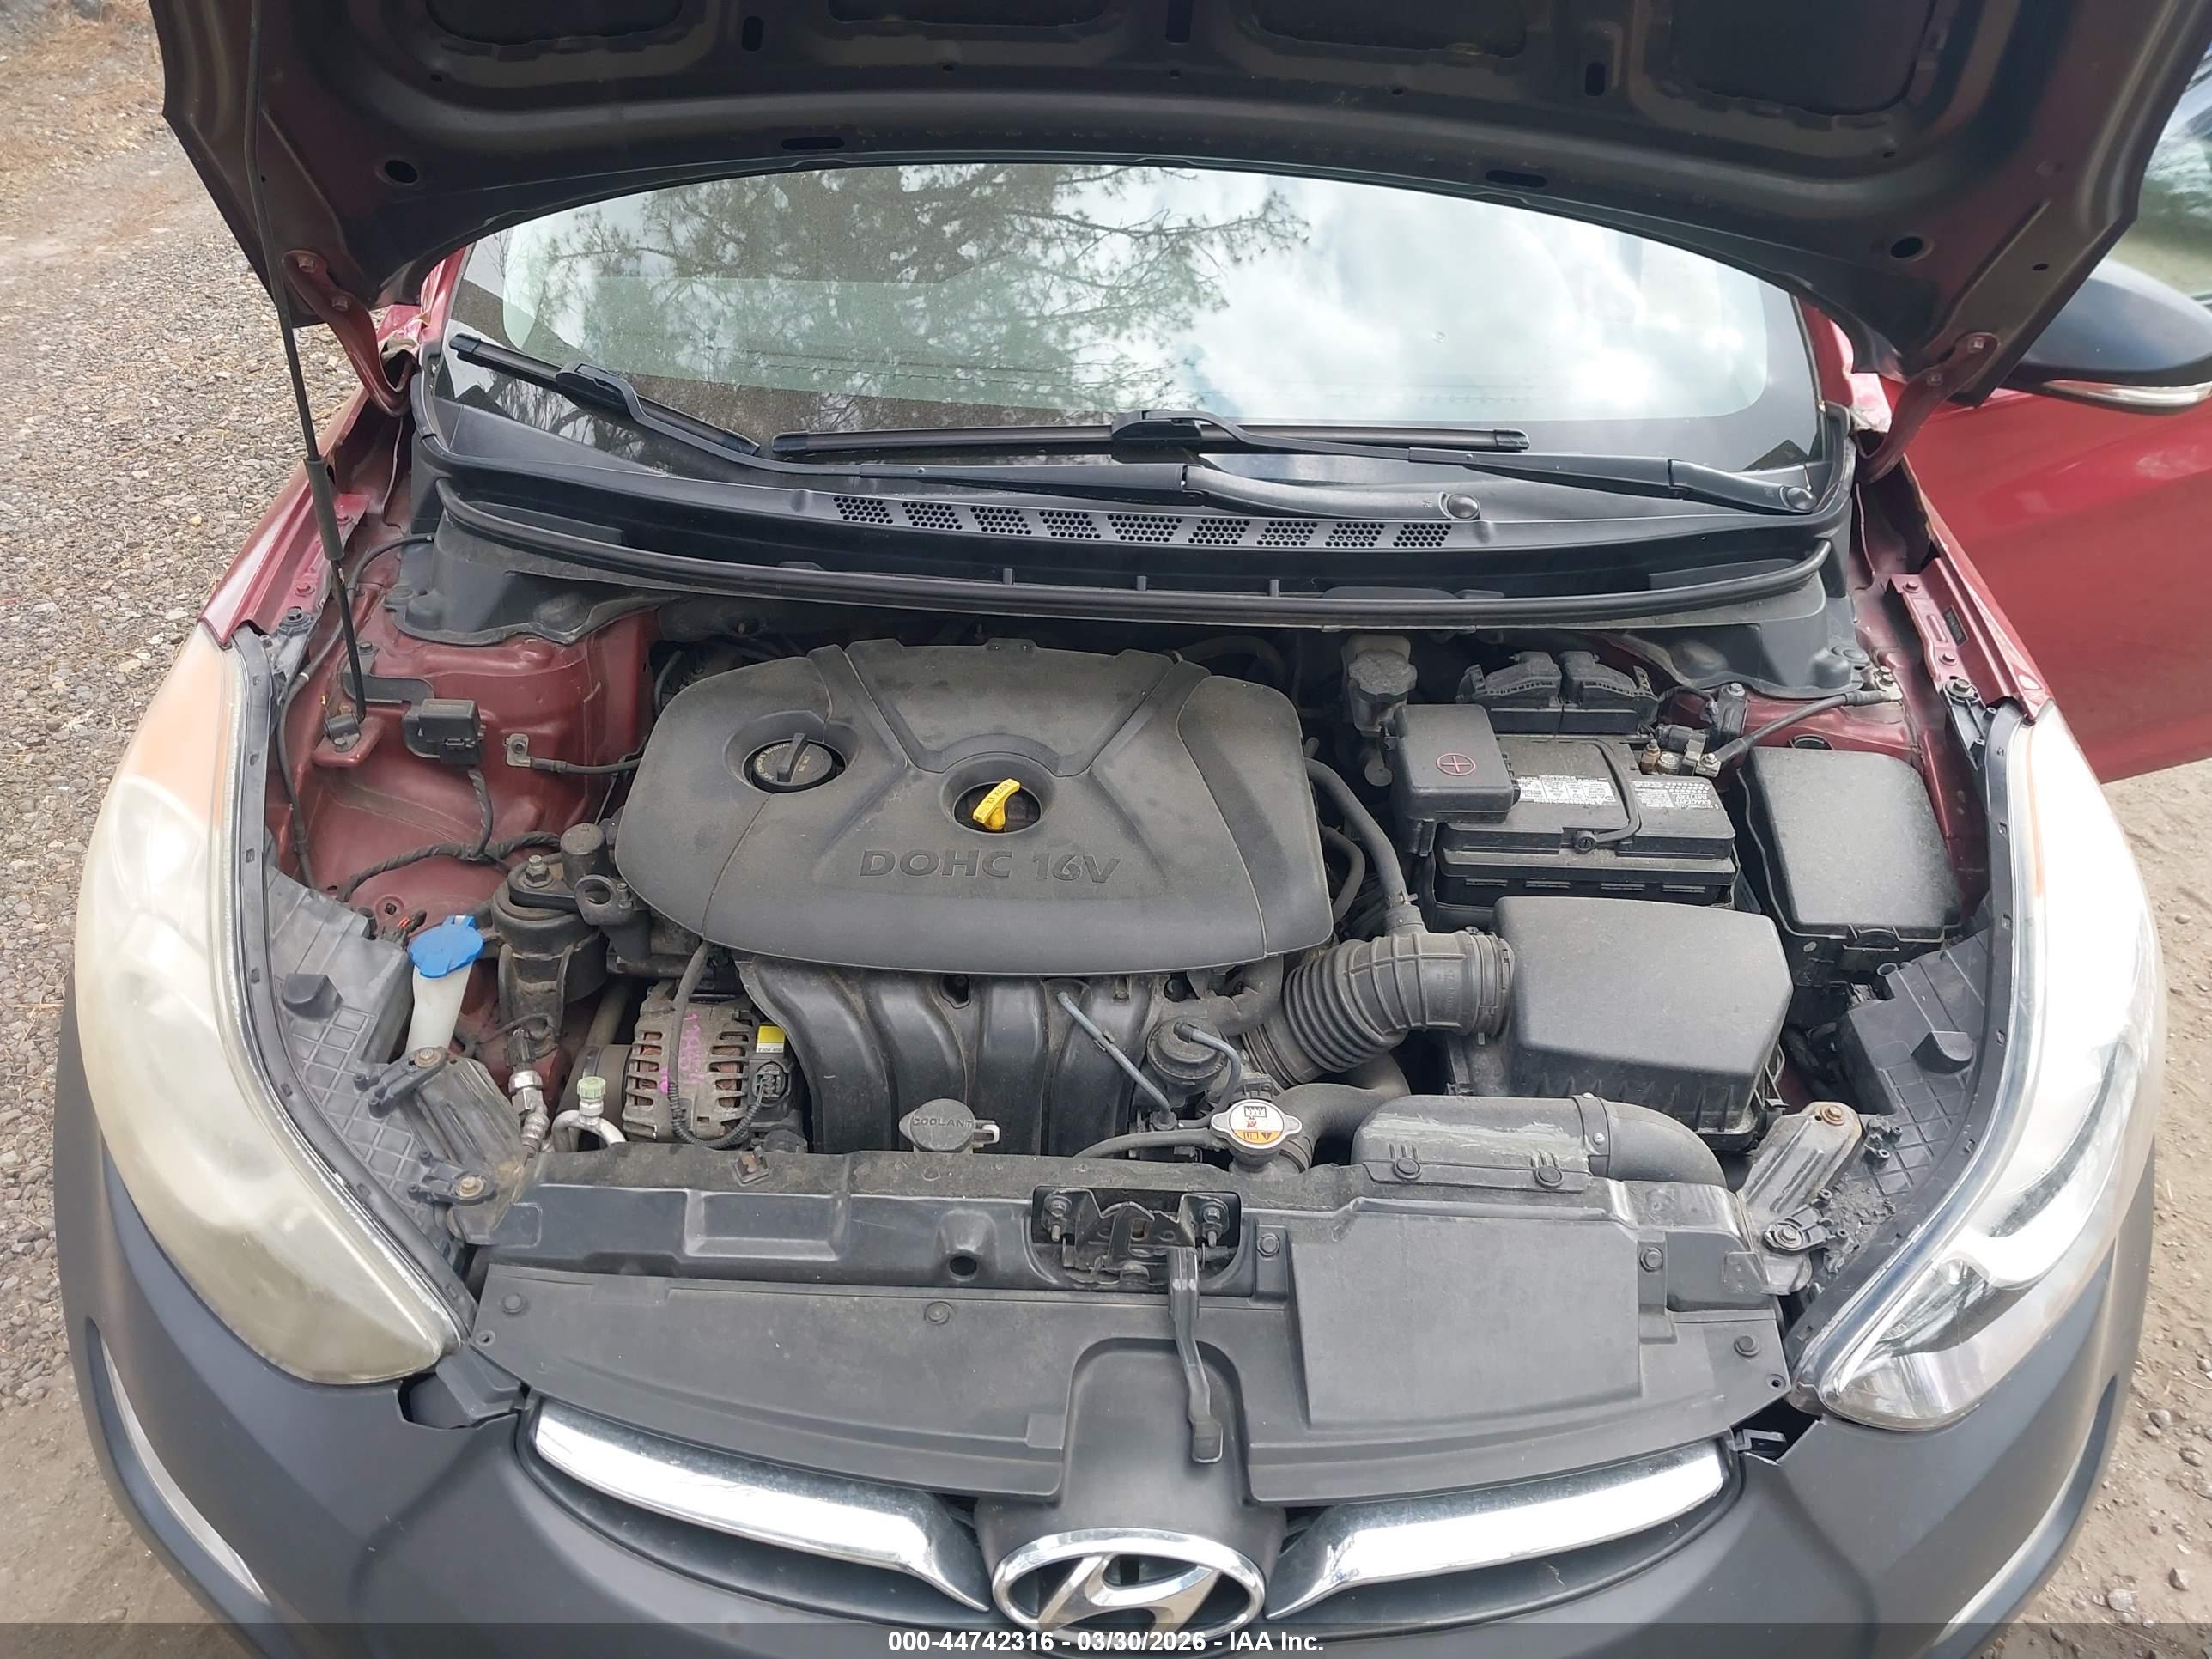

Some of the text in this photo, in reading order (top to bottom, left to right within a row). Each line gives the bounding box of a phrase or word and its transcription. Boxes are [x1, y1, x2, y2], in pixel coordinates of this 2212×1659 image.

[859, 849, 1121, 883] DOHC 16V
[912, 1117, 974, 1128] COOLANT
